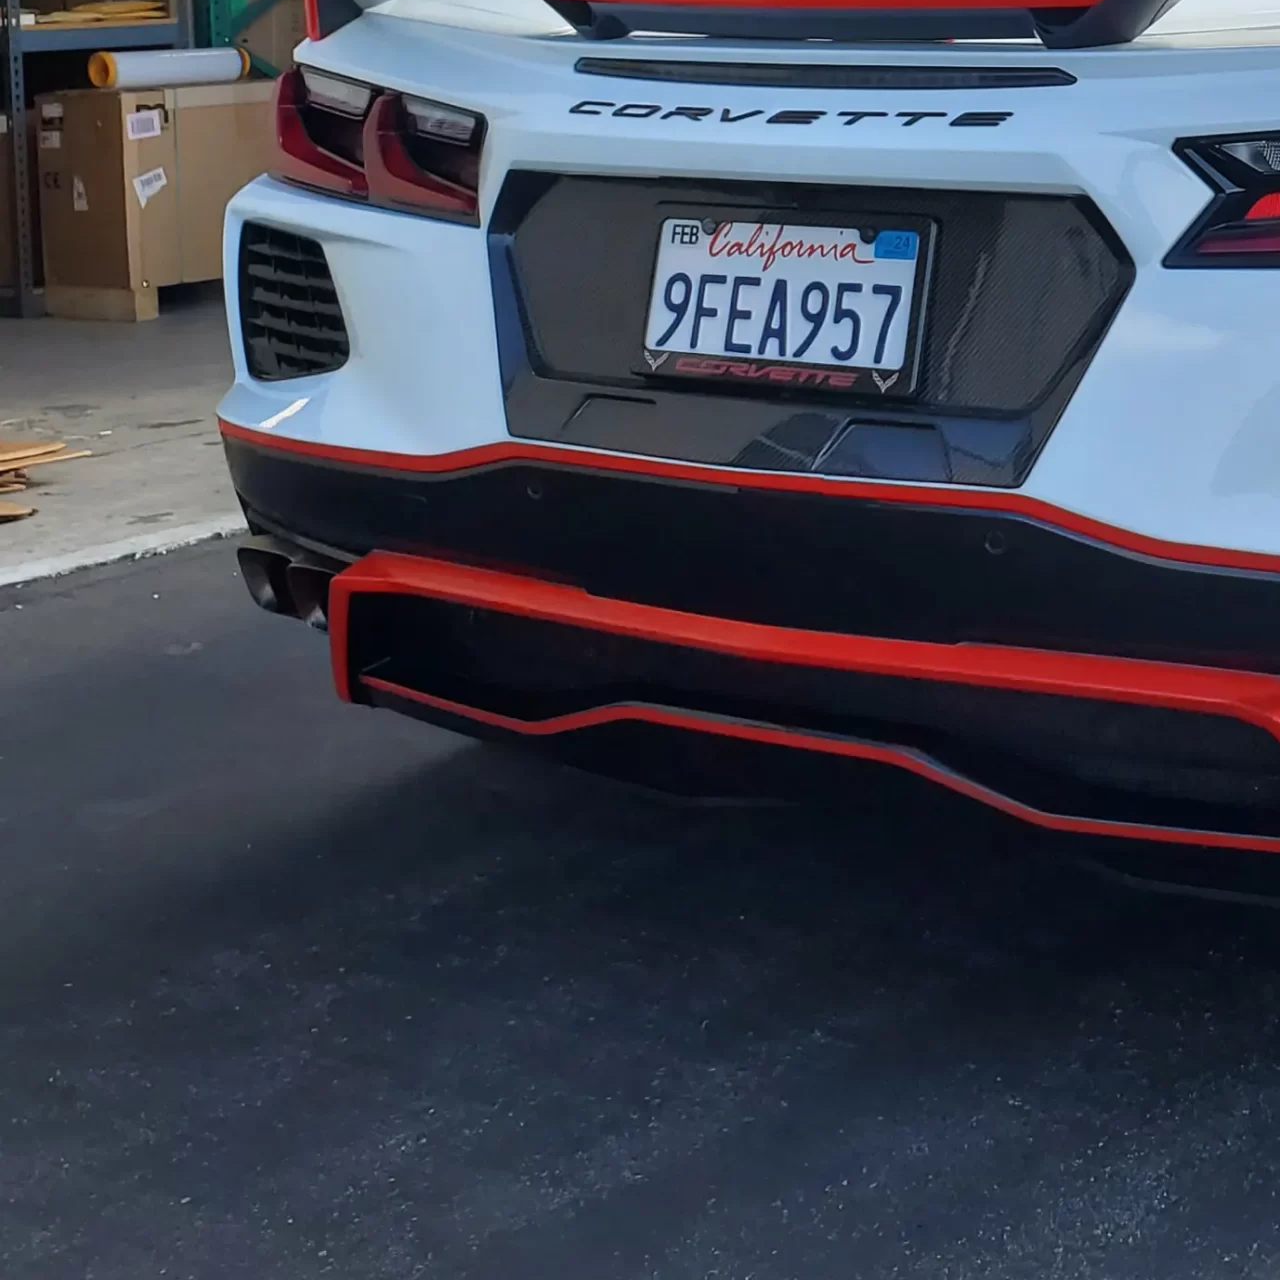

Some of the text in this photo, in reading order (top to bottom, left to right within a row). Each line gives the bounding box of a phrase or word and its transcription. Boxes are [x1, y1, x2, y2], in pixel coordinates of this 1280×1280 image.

[569, 100, 1015, 127] CORVETTE
[671, 223, 700, 245] FEB
[708, 221, 875, 272] California
[655, 271, 903, 365] 9FEA957
[675, 357, 858, 387] CORVETTE
